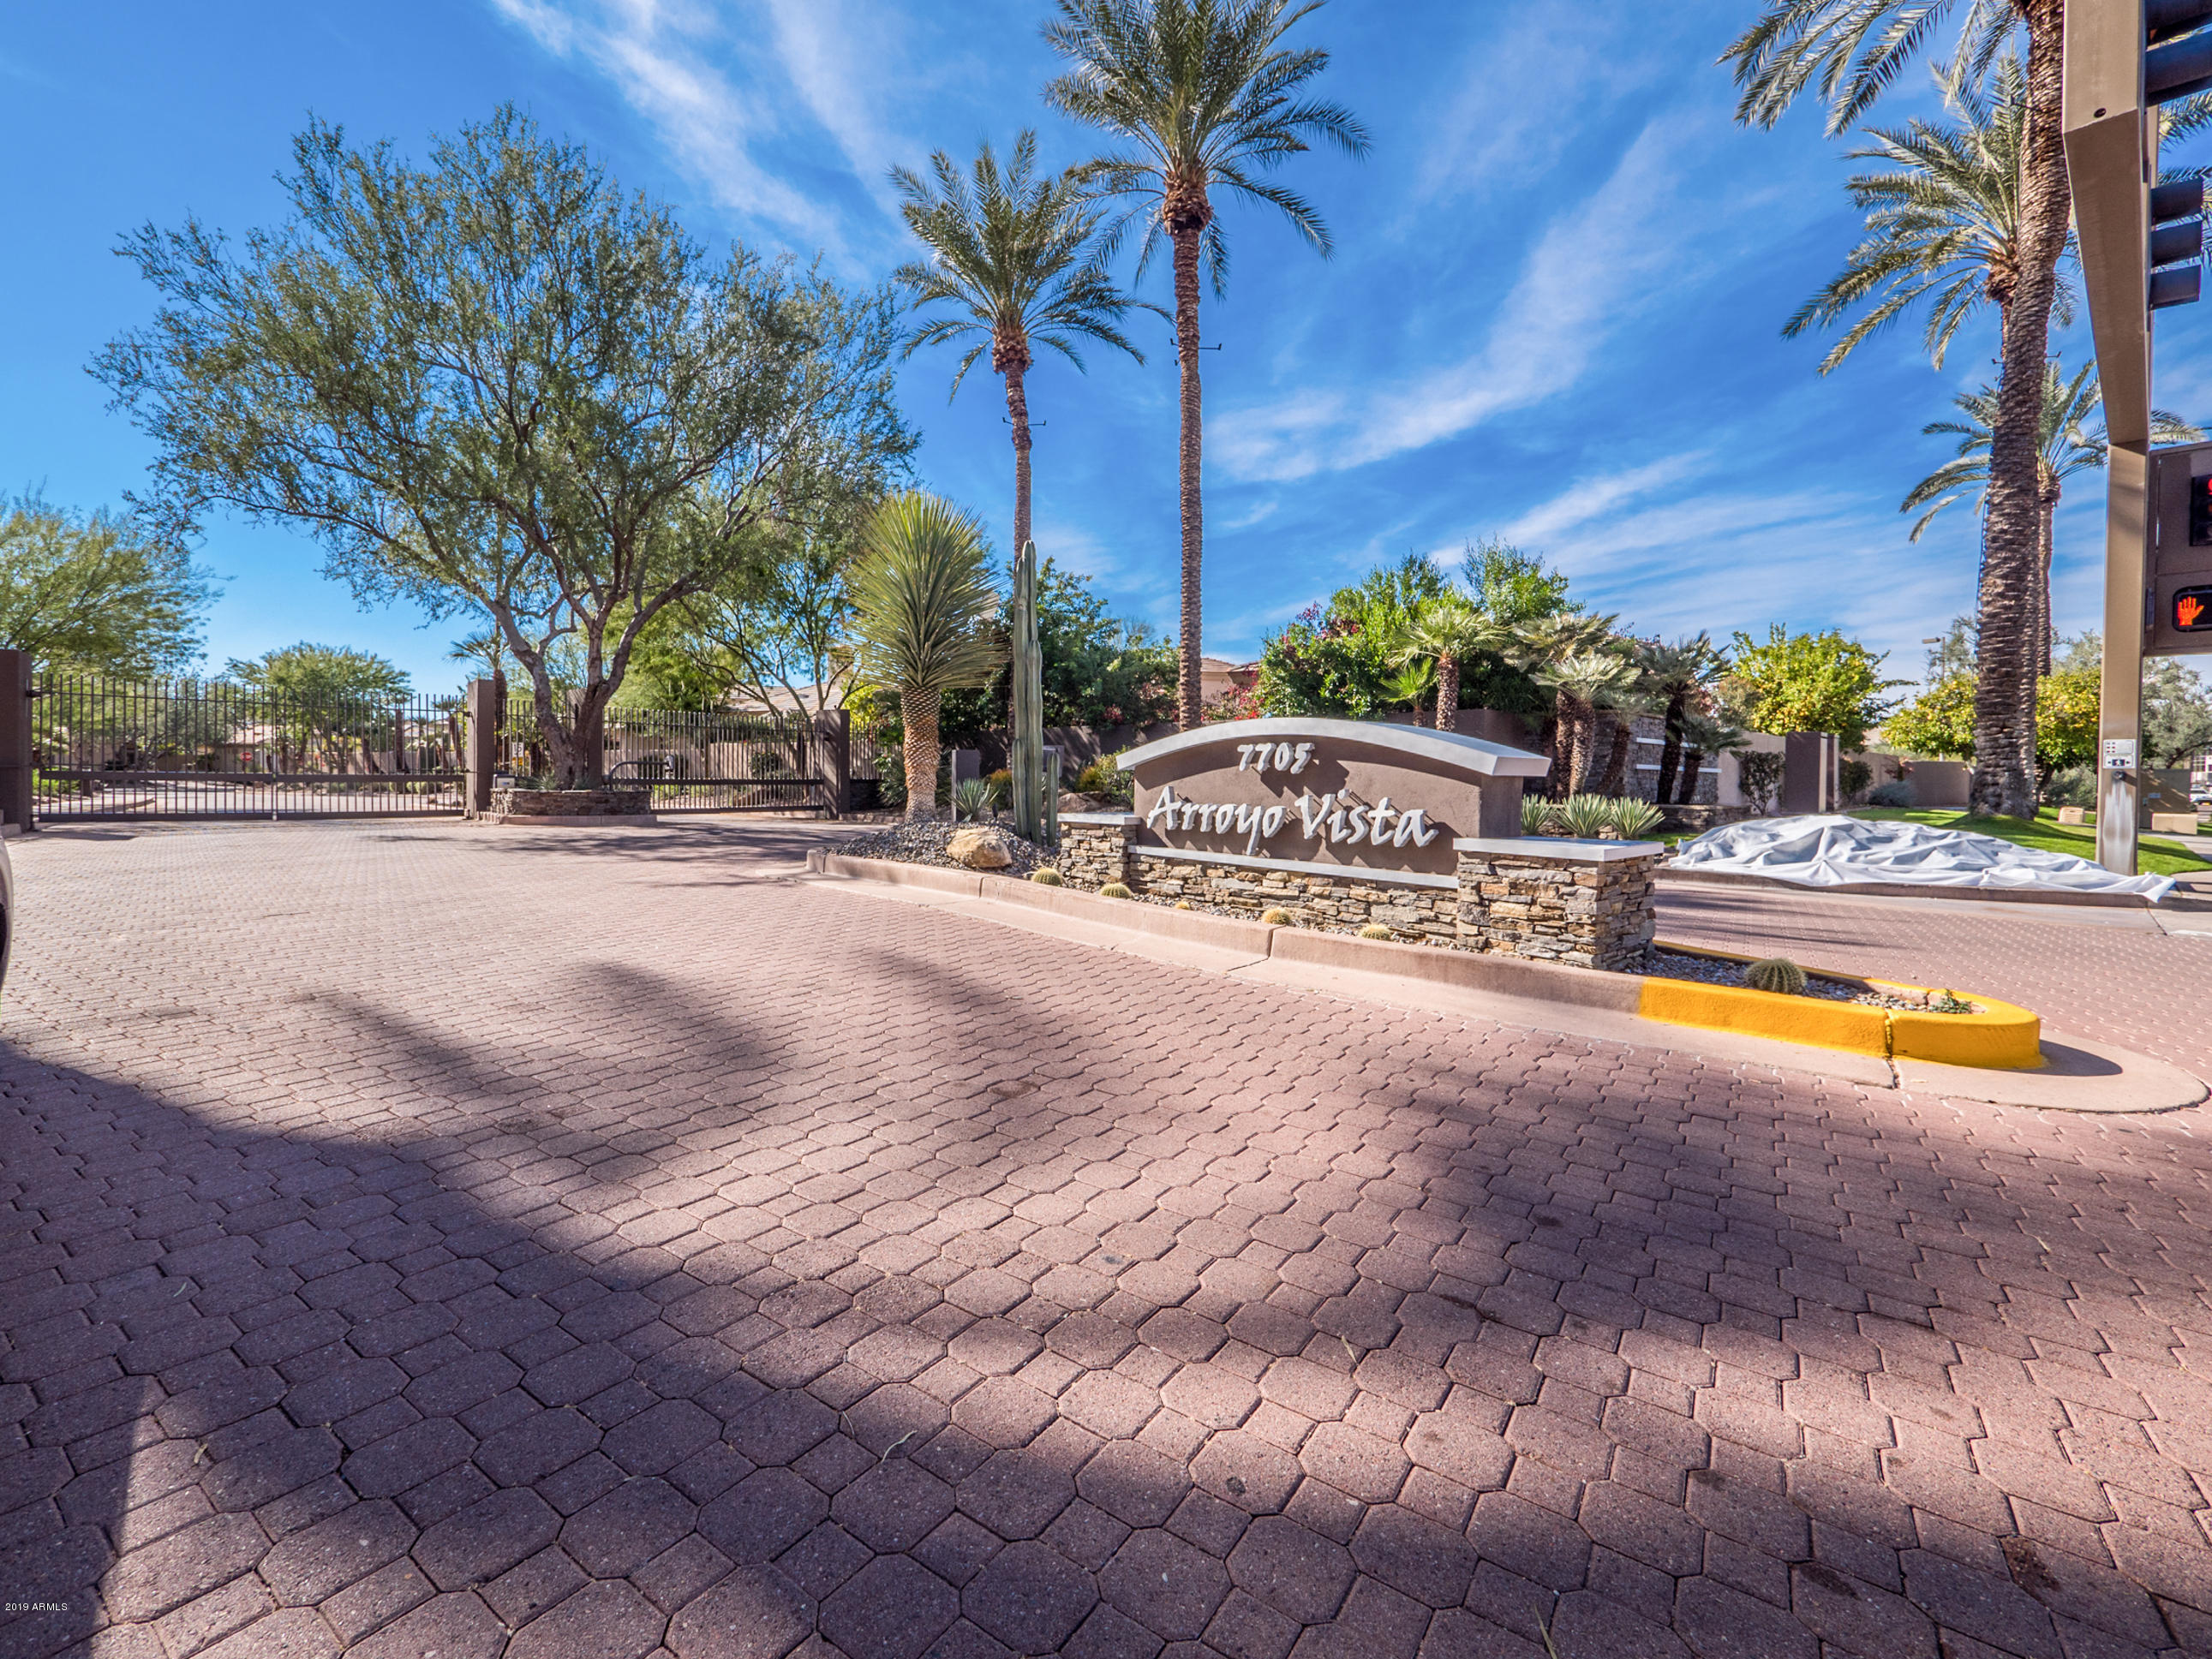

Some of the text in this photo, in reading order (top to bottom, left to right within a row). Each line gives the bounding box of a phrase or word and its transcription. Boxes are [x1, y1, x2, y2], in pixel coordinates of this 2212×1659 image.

[1237, 742, 1315, 774] 7705
[1146, 785, 1439, 856] Arroyo Vista
